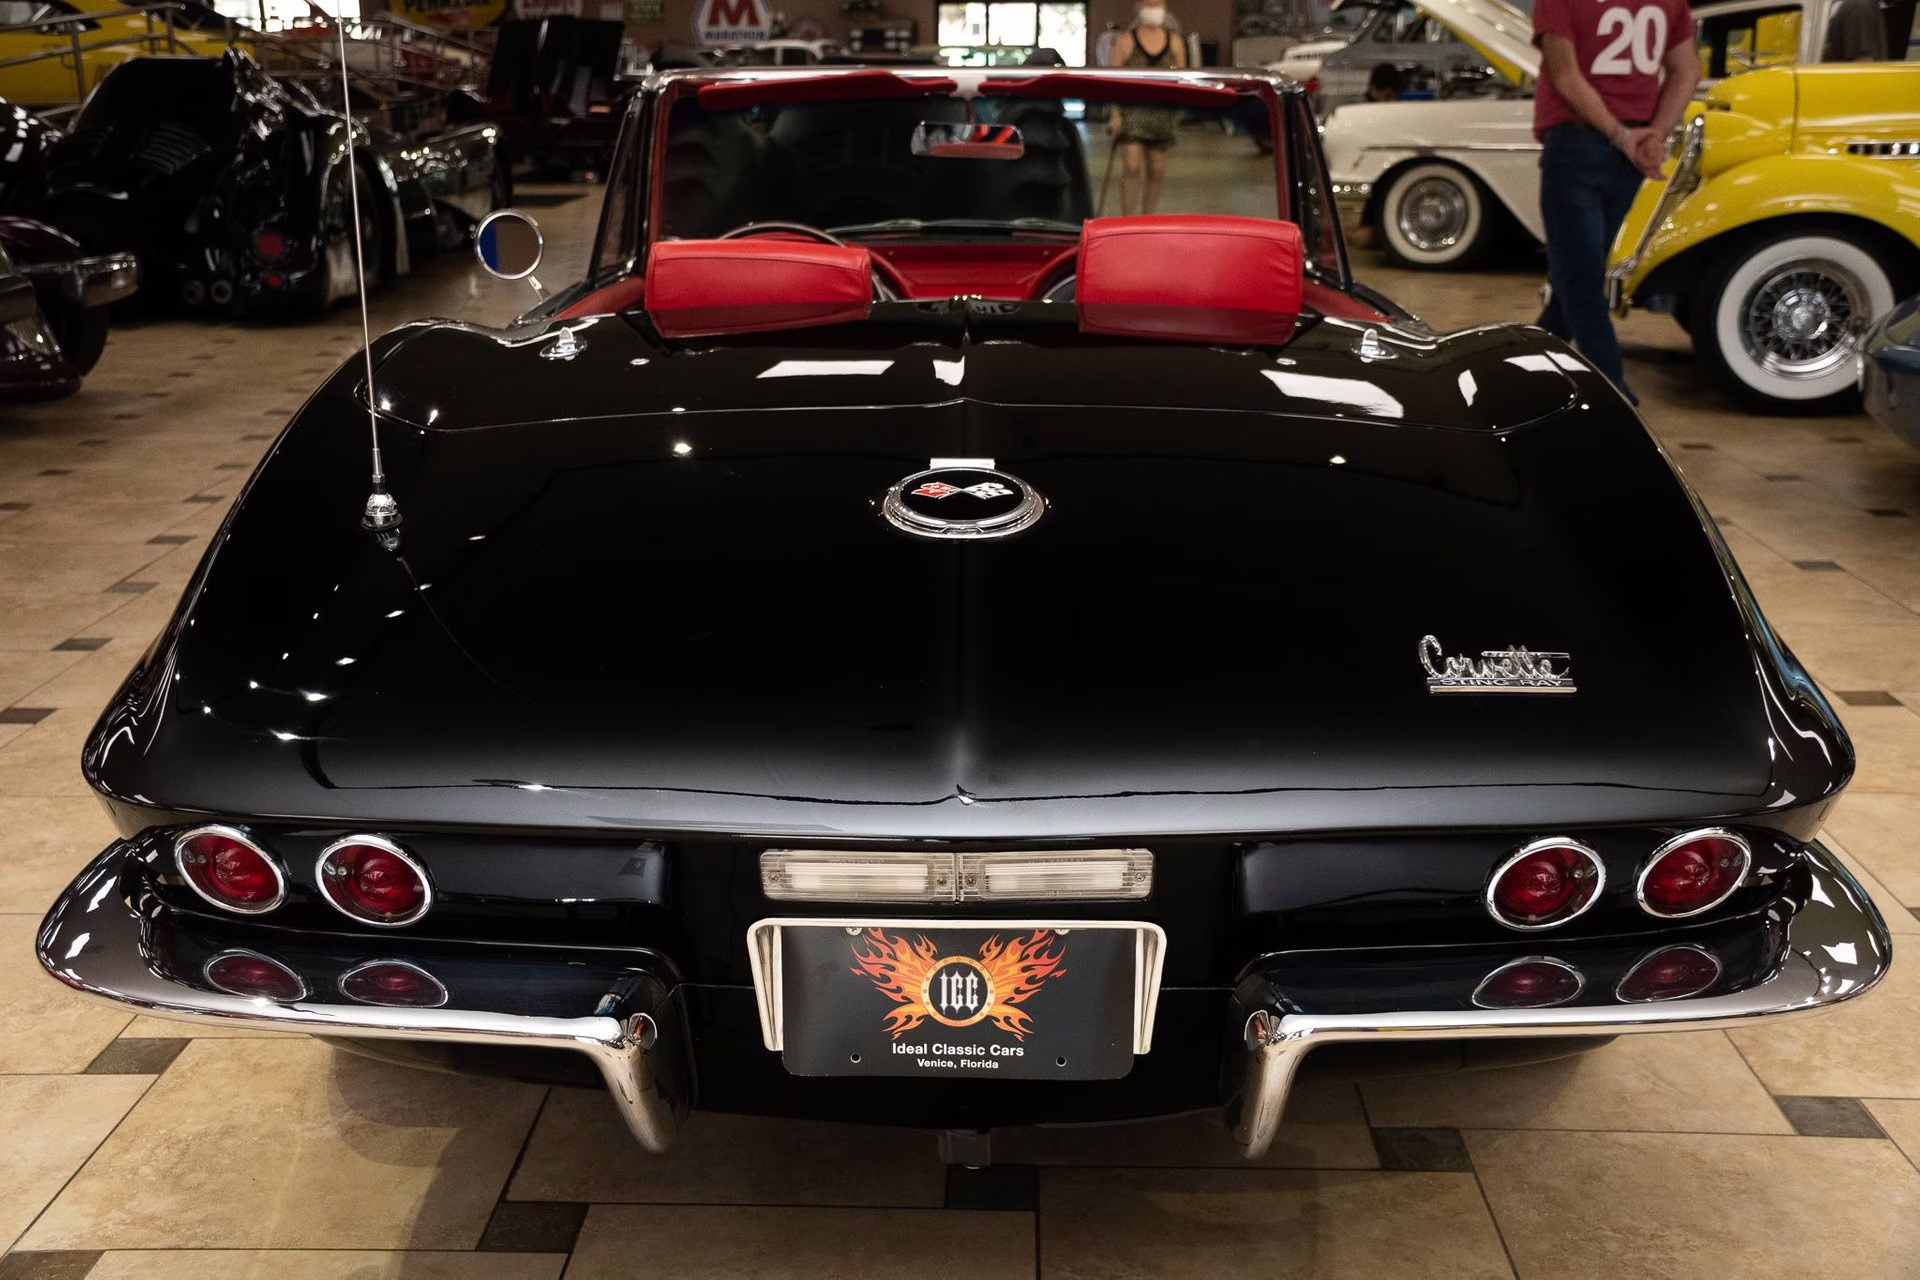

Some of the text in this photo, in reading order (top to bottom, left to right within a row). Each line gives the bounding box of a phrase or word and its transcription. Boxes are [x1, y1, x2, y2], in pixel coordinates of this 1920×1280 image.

[1589, 3, 1668, 76] 20
[1418, 634, 1571, 679] Corvette
[1439, 678, 1563, 687] STING RAY
[939, 969, 979, 1015] ICC
[892, 1042, 1025, 1057] Ideal Classic Cars
[917, 1058, 999, 1069] Venice, Florida
